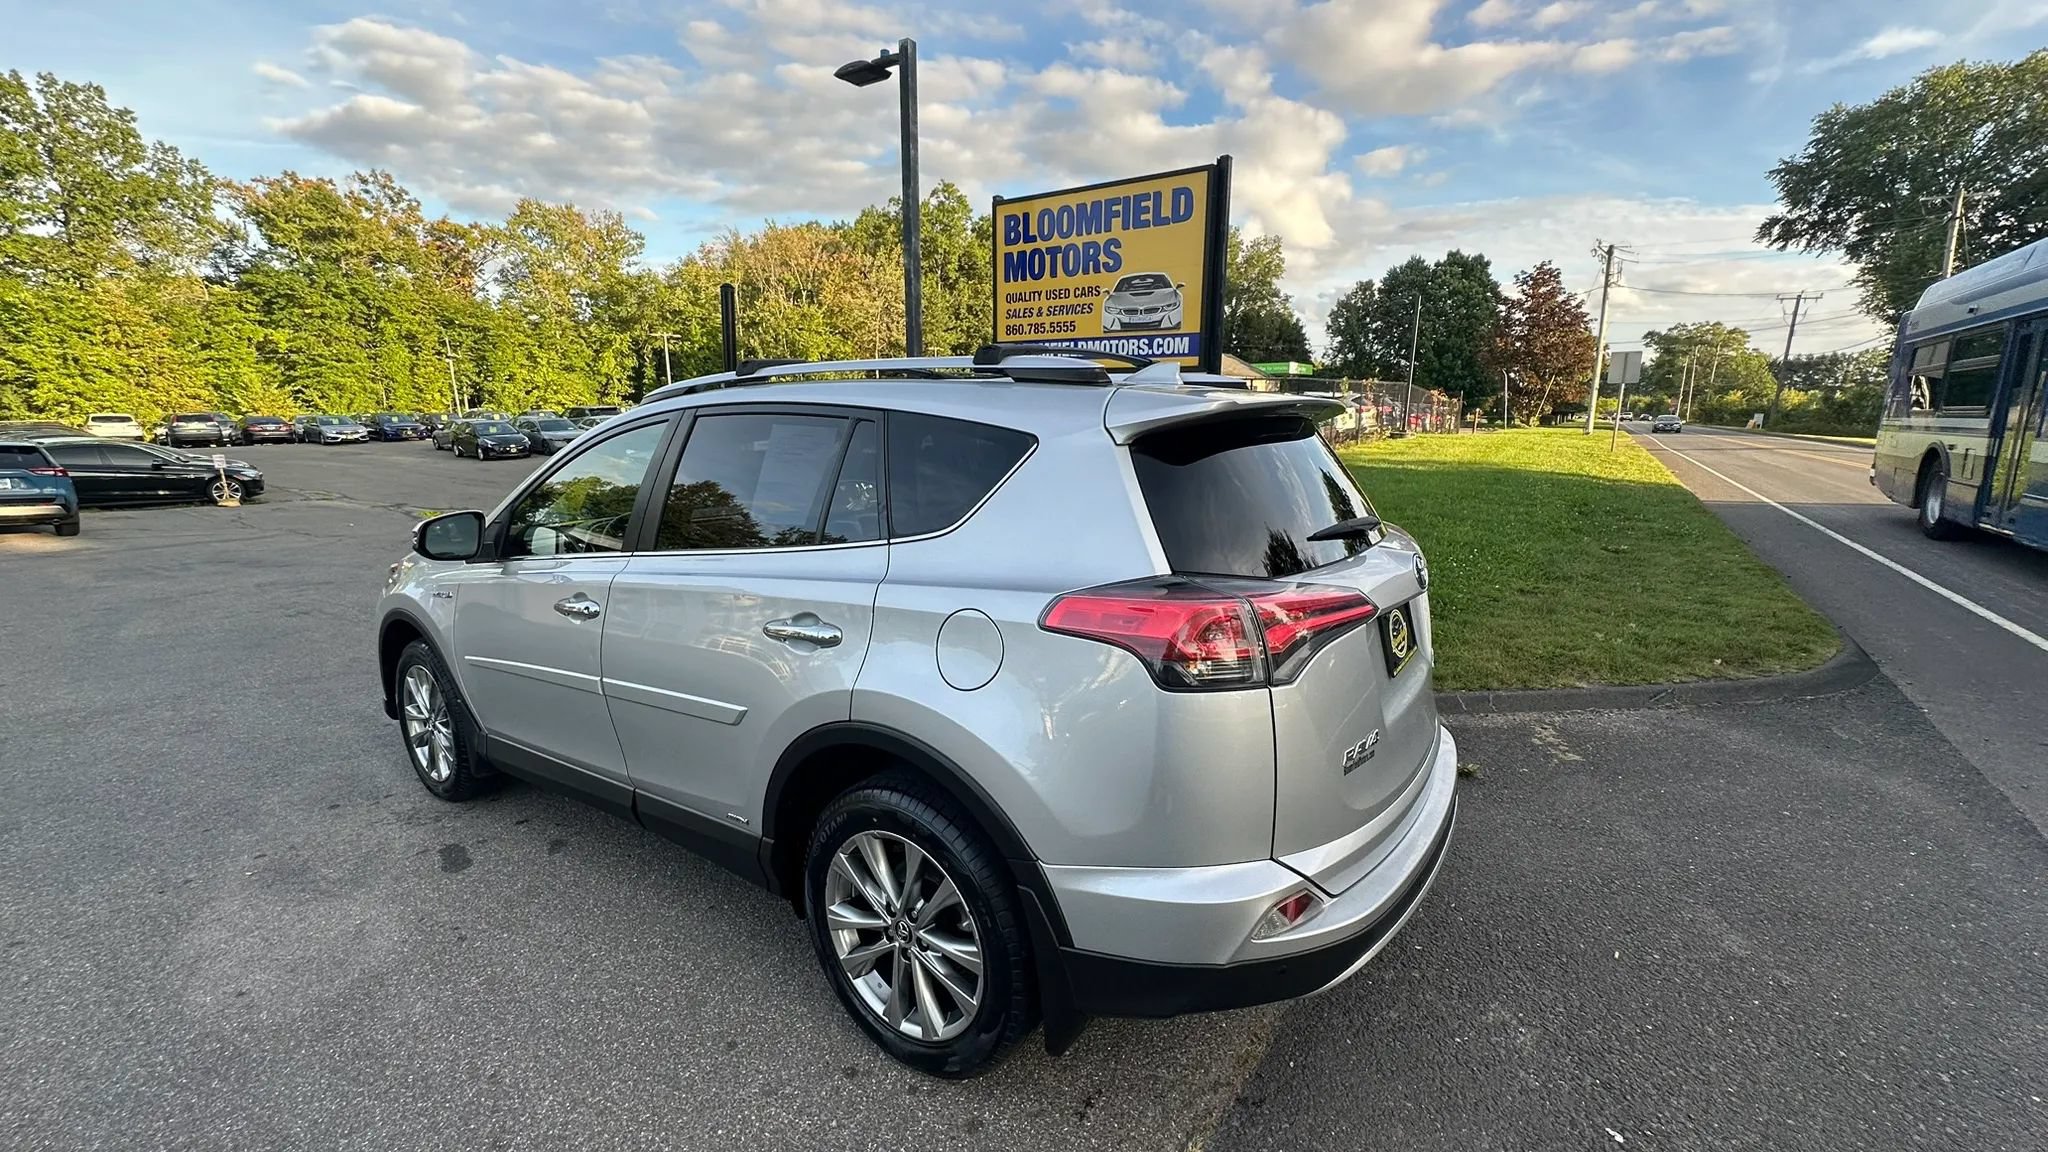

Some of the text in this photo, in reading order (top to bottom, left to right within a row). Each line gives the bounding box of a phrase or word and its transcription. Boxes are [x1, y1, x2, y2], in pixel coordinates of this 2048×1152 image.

[1004, 187, 1194, 246] BLOOMFIELD
[1004, 238, 1122, 283] MOTORS
[1005, 285, 1101, 304] QUALITY USED CARS
[1005, 303, 1094, 320] SALES & SERVICES
[1005, 321, 1076, 336] 860.785.5555
